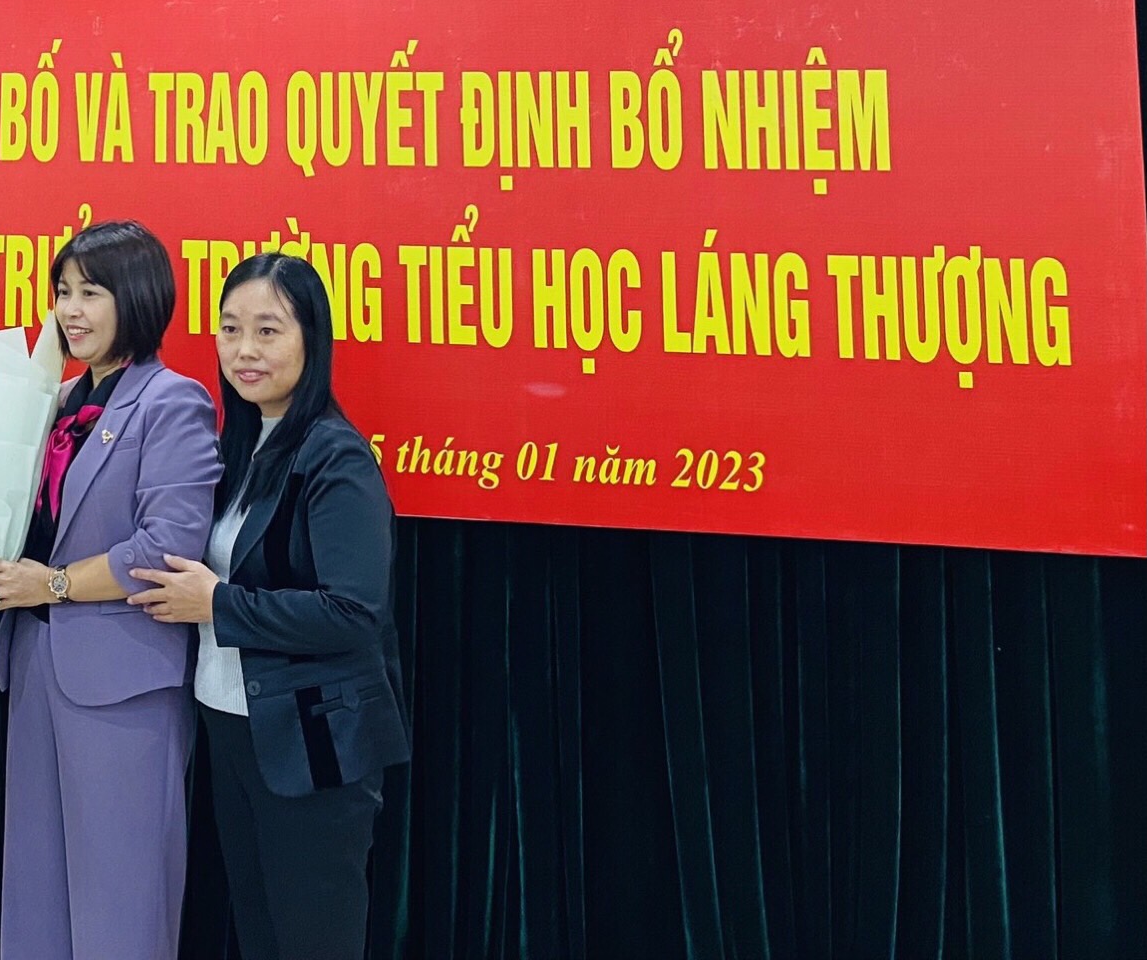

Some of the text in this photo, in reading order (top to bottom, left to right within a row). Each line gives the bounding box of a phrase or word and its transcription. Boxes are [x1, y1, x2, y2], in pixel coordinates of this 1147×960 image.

[0, 40, 61, 162] BỐ
[75, 52, 133, 163] VÀ
[149, 71, 268, 165] TRAO
[287, 40, 444, 176] QUYẾT
[460, 71, 591, 191] ĐỊNH
[610, 29, 682, 170] BỔ
[702, 48, 891, 195] NHIỆM
[399, 205, 513, 348] TIỂU
[533, 248, 642, 374] HỌC
[662, 229, 811, 358] LÁNG
[827, 246, 1071, 388] THƯỢNG
[395, 436, 505, 489] tháng
[517, 443, 557, 480] 01
[572, 444, 658, 486] năm
[672, 449, 765, 491] 2023
